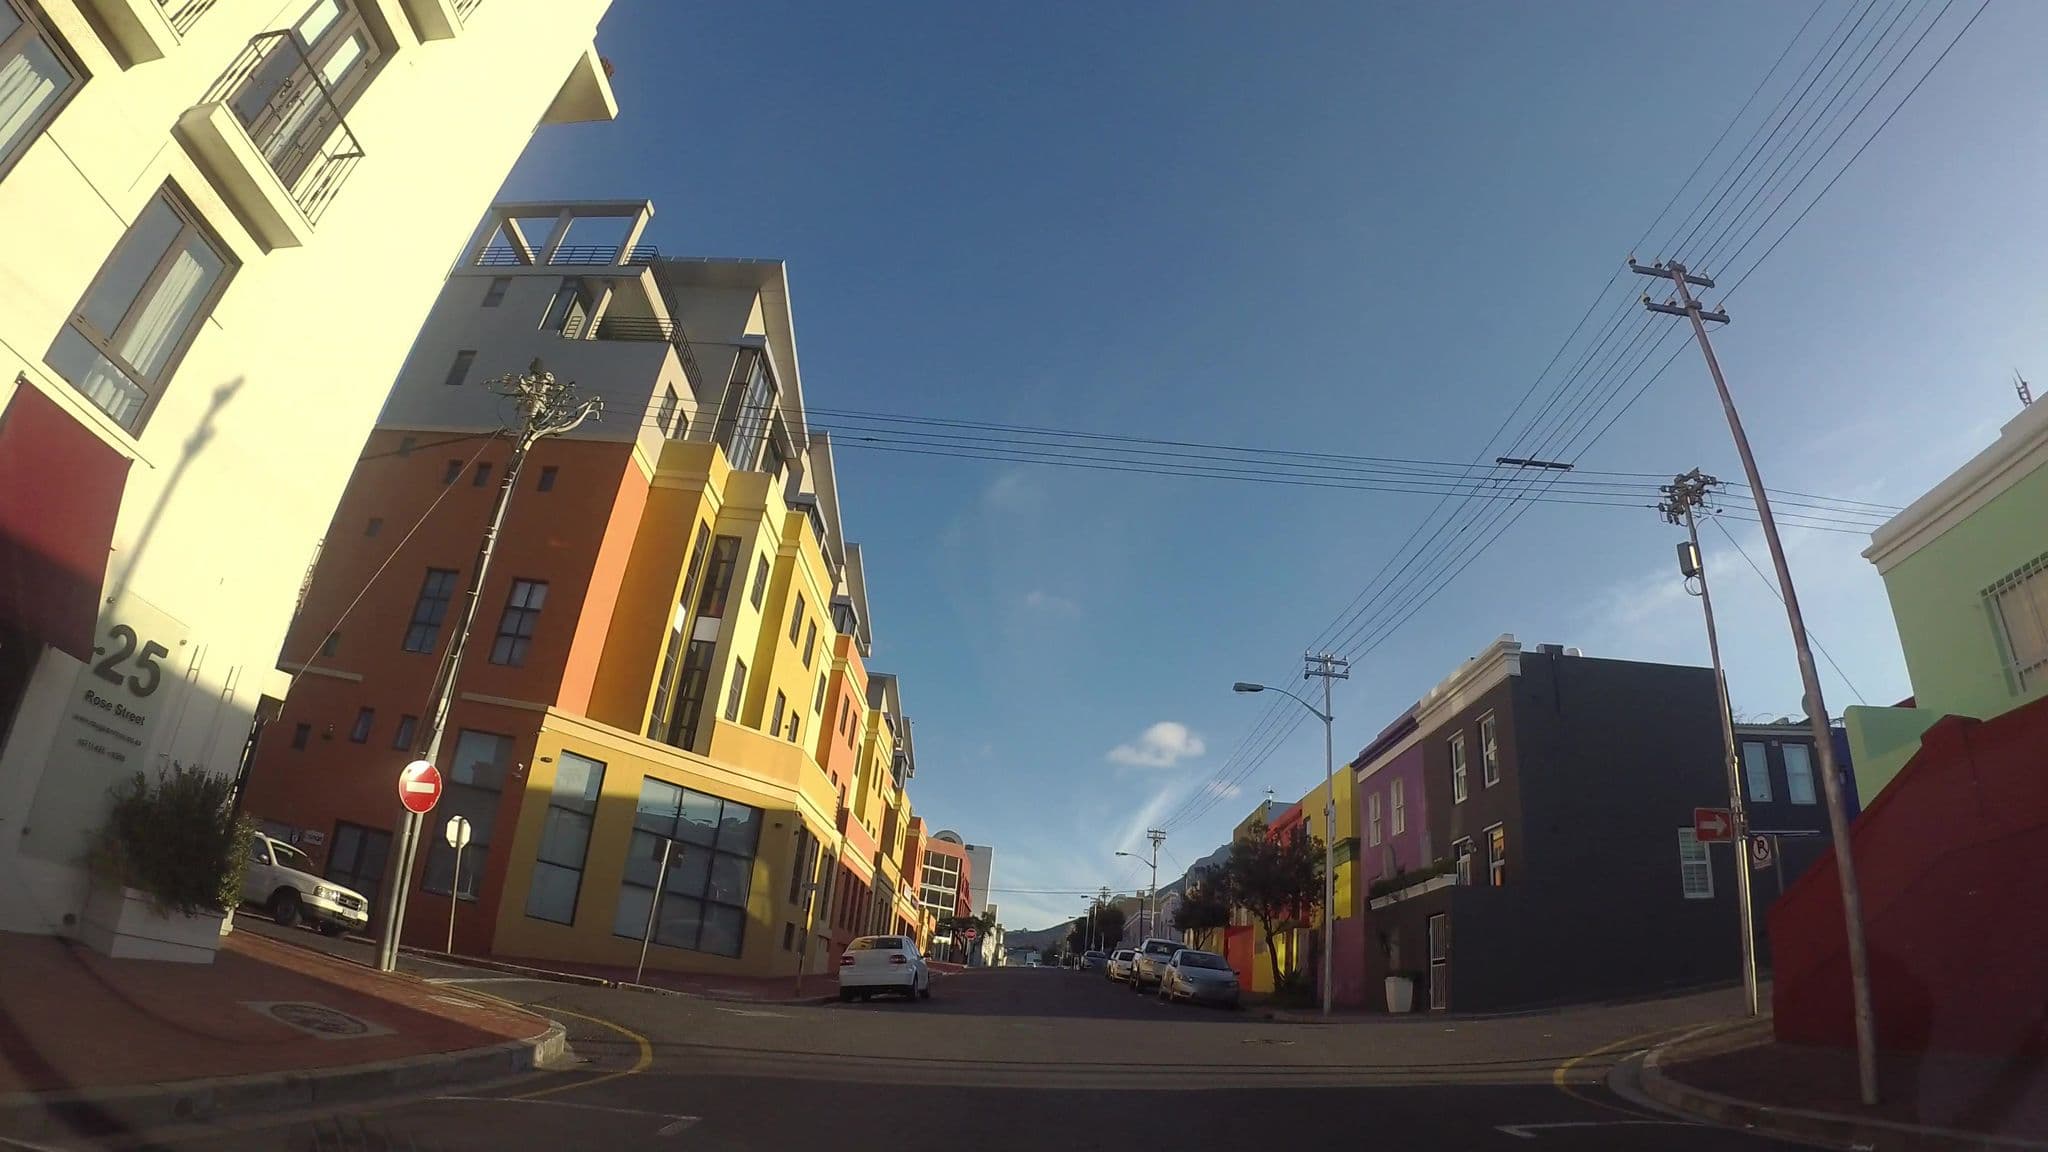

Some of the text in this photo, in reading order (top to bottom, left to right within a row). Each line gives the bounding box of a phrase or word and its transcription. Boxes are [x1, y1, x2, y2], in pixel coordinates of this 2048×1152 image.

[94, 624, 169, 698] 25
[85, 689, 146, 726] Rose Street
